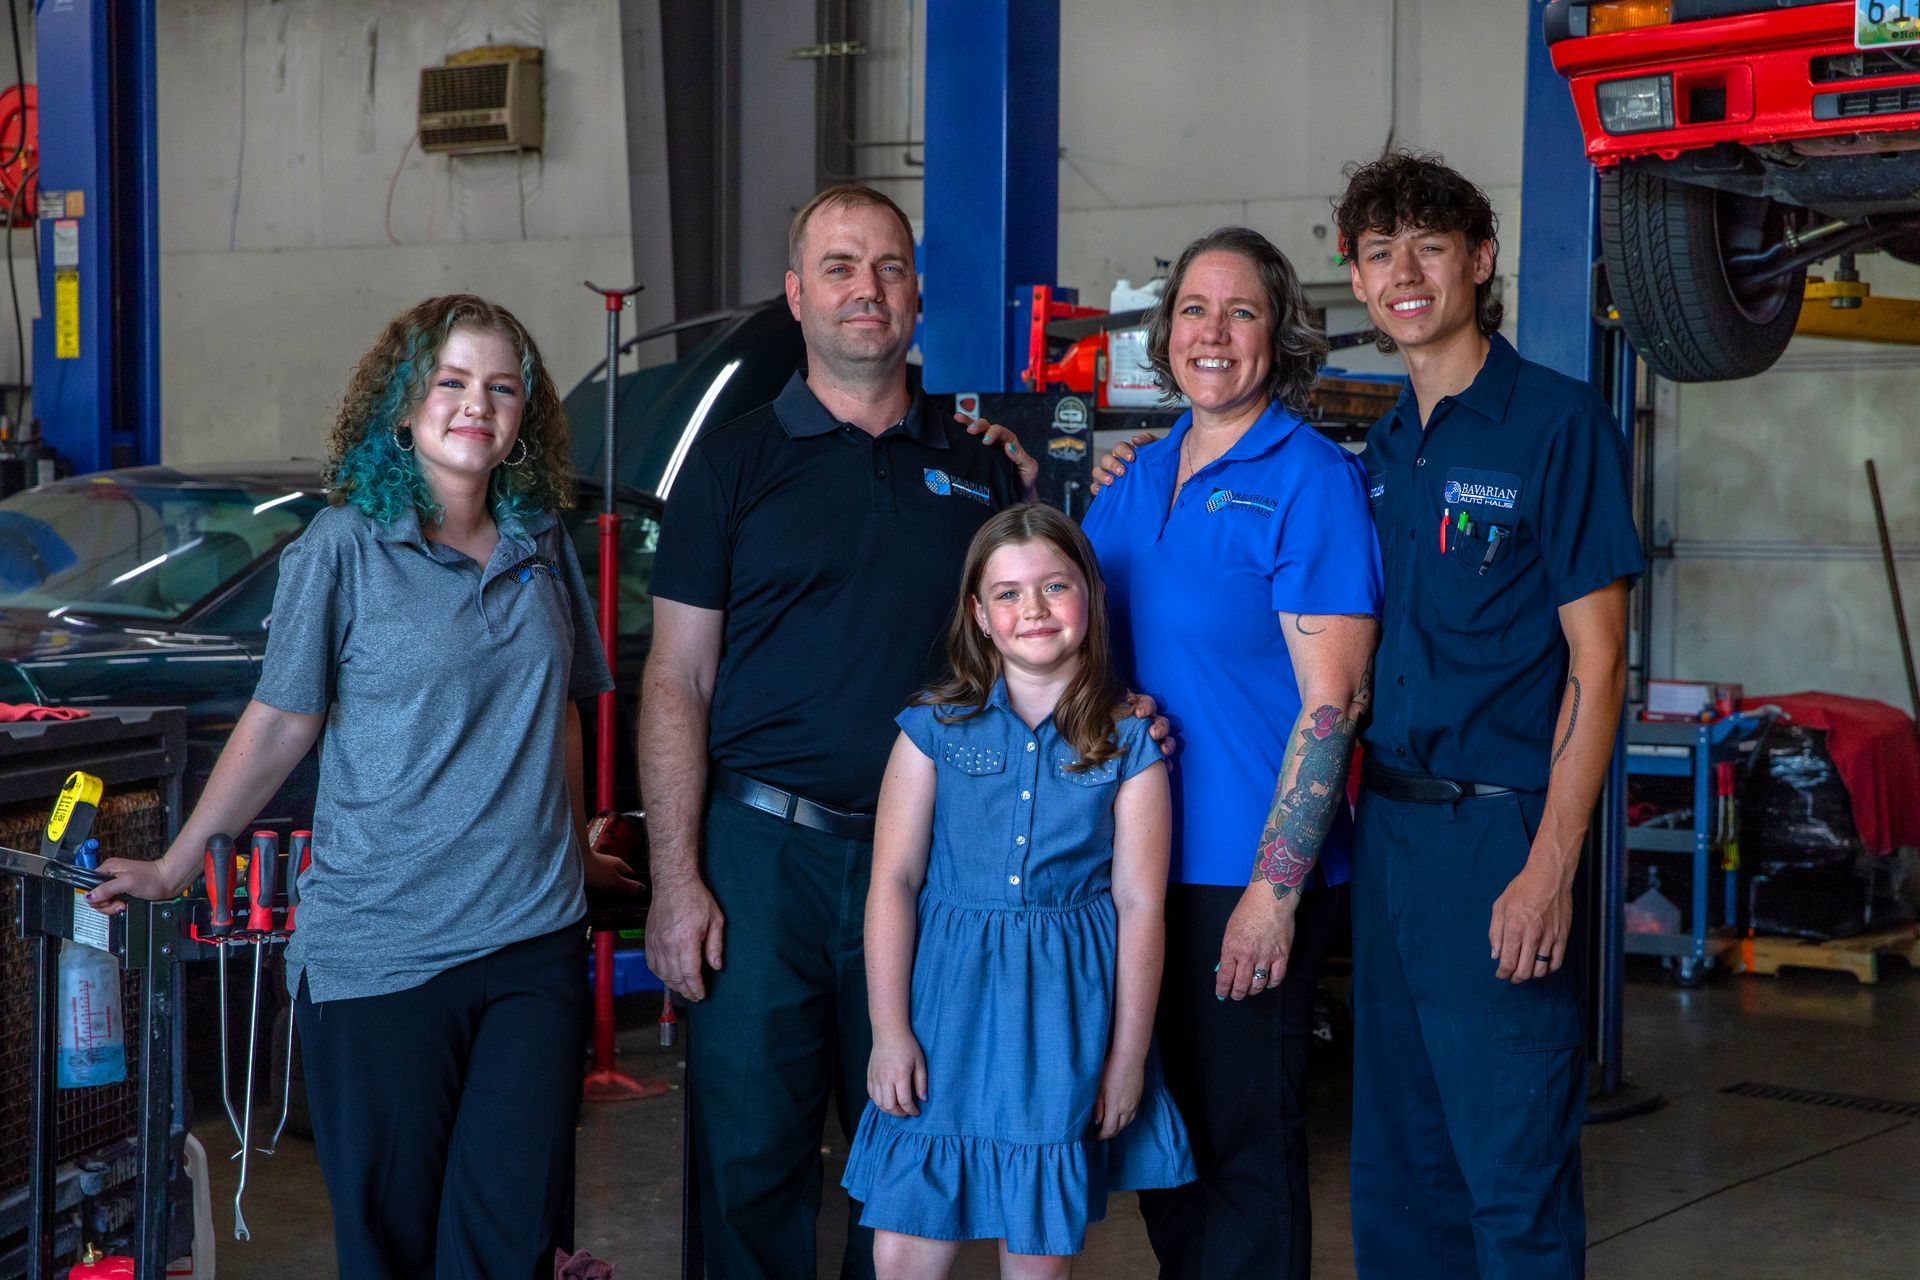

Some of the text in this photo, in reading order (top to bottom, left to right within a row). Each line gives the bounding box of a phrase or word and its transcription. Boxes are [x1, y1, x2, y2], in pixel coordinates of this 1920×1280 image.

[1868, 0, 1920, 24] 61
[1462, 483, 1518, 500] BAVARIAN
[1460, 496, 1514, 509] AUTO HAUS
